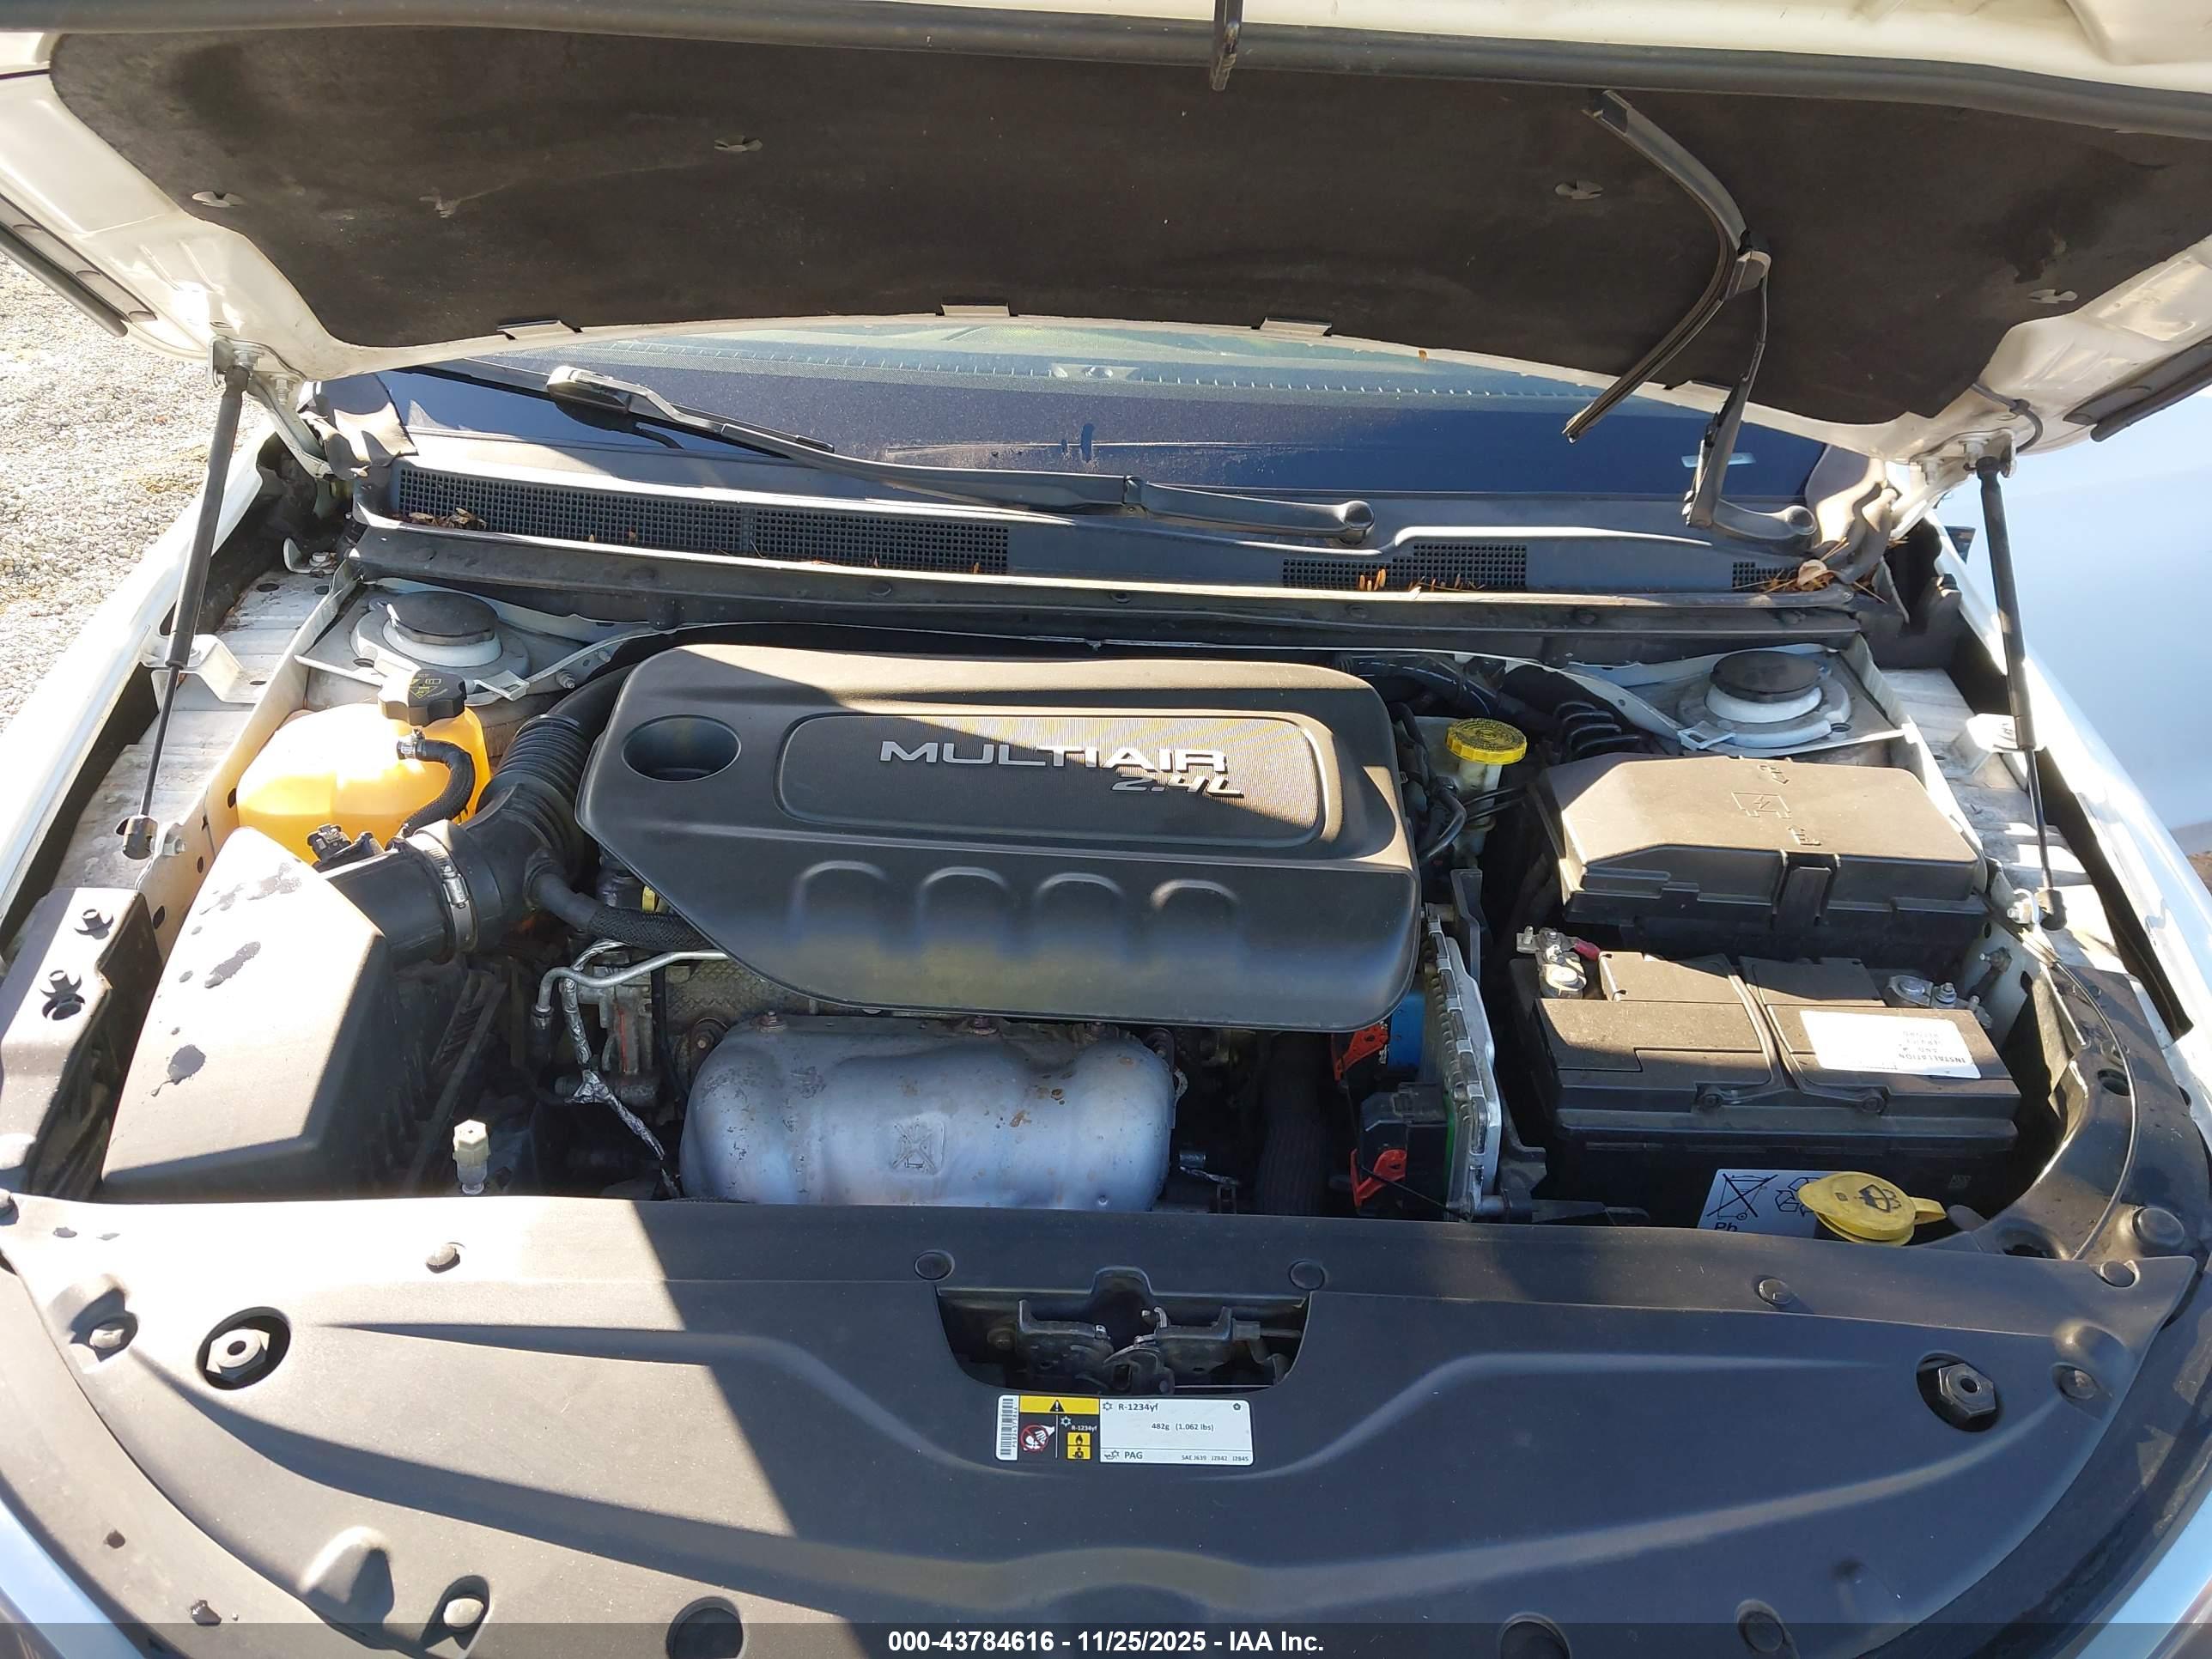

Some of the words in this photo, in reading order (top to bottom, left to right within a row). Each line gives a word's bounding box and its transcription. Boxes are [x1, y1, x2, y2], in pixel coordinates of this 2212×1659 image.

[879, 740, 1228, 773] MULTIAIR
[1110, 774, 1244, 798] 2.4L
[1899, 1054, 1966, 1064] INSTALLATION
[1714, 1222, 1738, 1231] Pb
[1118, 1402, 1158, 1413] R-1234yf
[1175, 1423, 1199, 1431] (1.062
[1124, 1451, 1143, 1460] PAG
